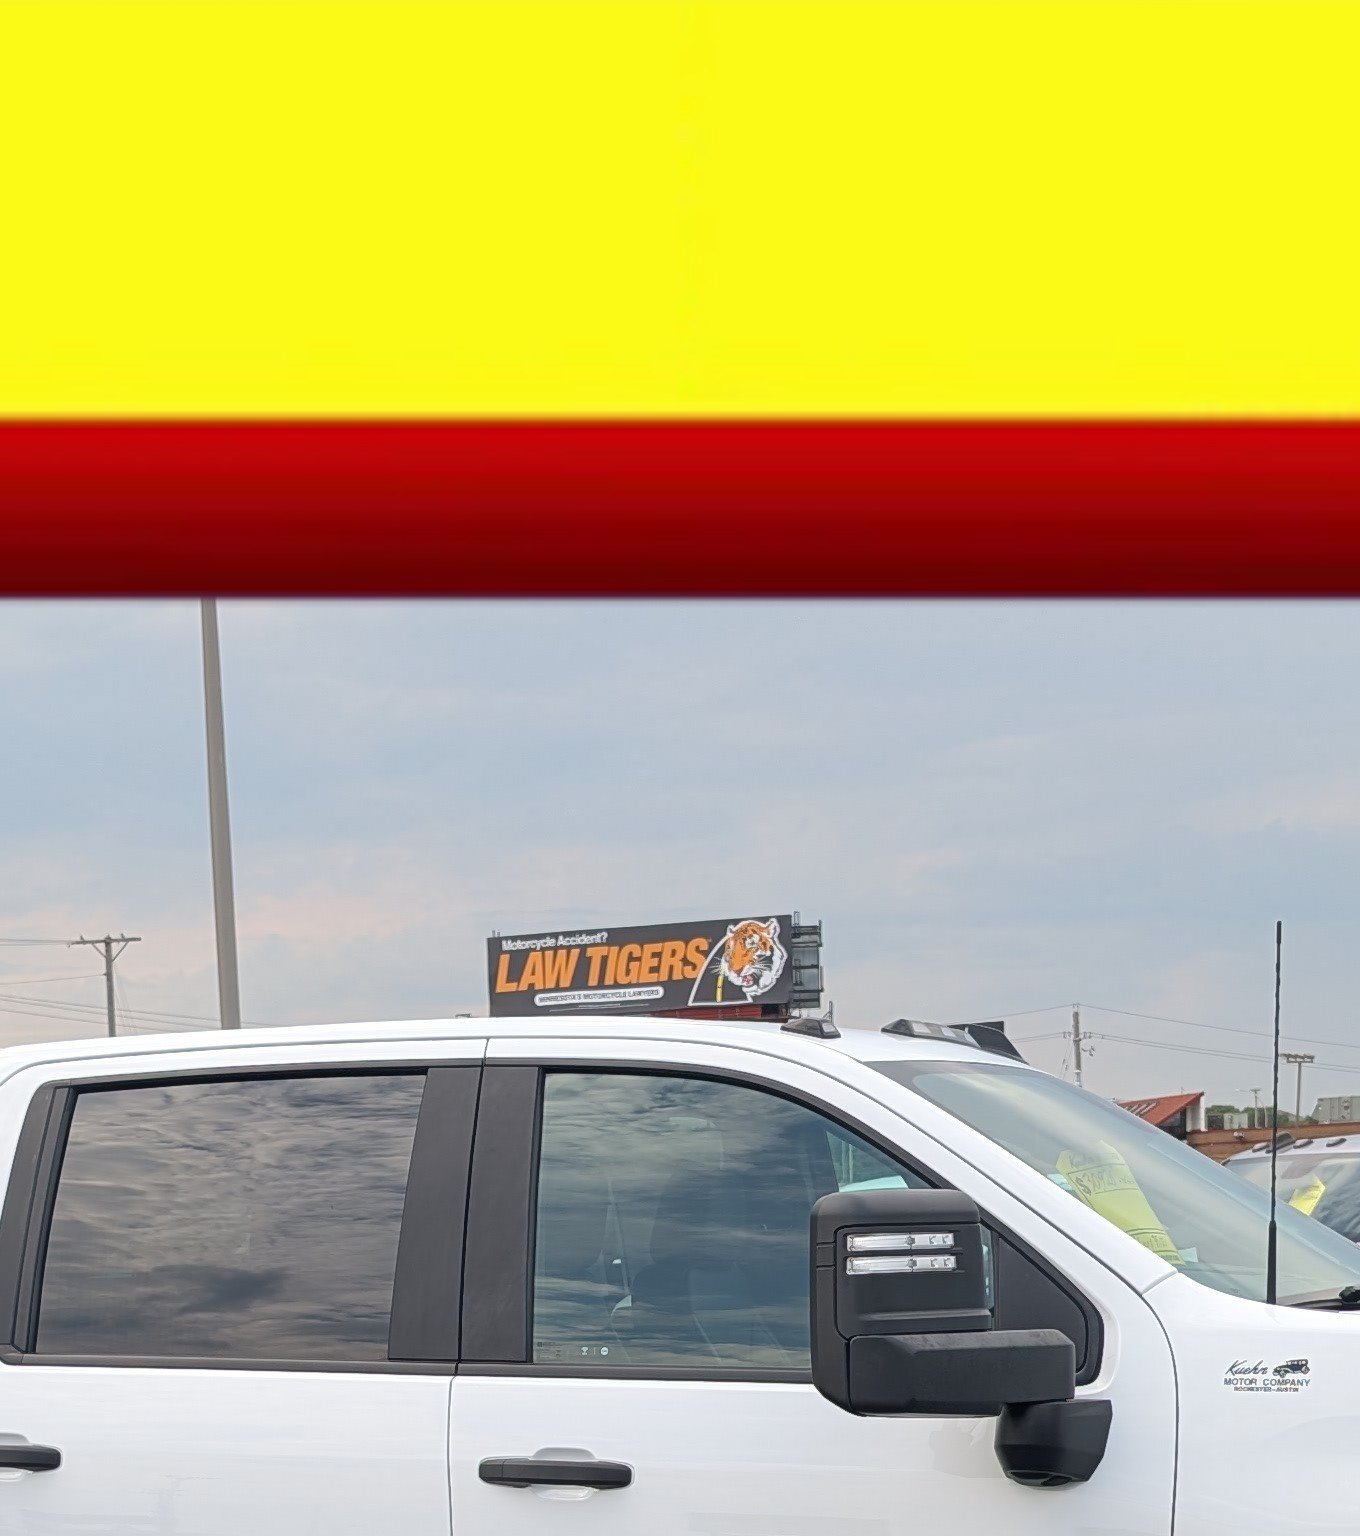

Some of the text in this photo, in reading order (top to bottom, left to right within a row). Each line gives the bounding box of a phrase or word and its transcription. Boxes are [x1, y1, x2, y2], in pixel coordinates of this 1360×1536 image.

[502, 932, 608, 951] Motorcycle Accident?
[495, 938, 710, 993] LAW TIGERS
[1225, 1360, 1268, 1376] Kuehn
[1223, 1378, 1311, 1387] MOTOR COMPANY
